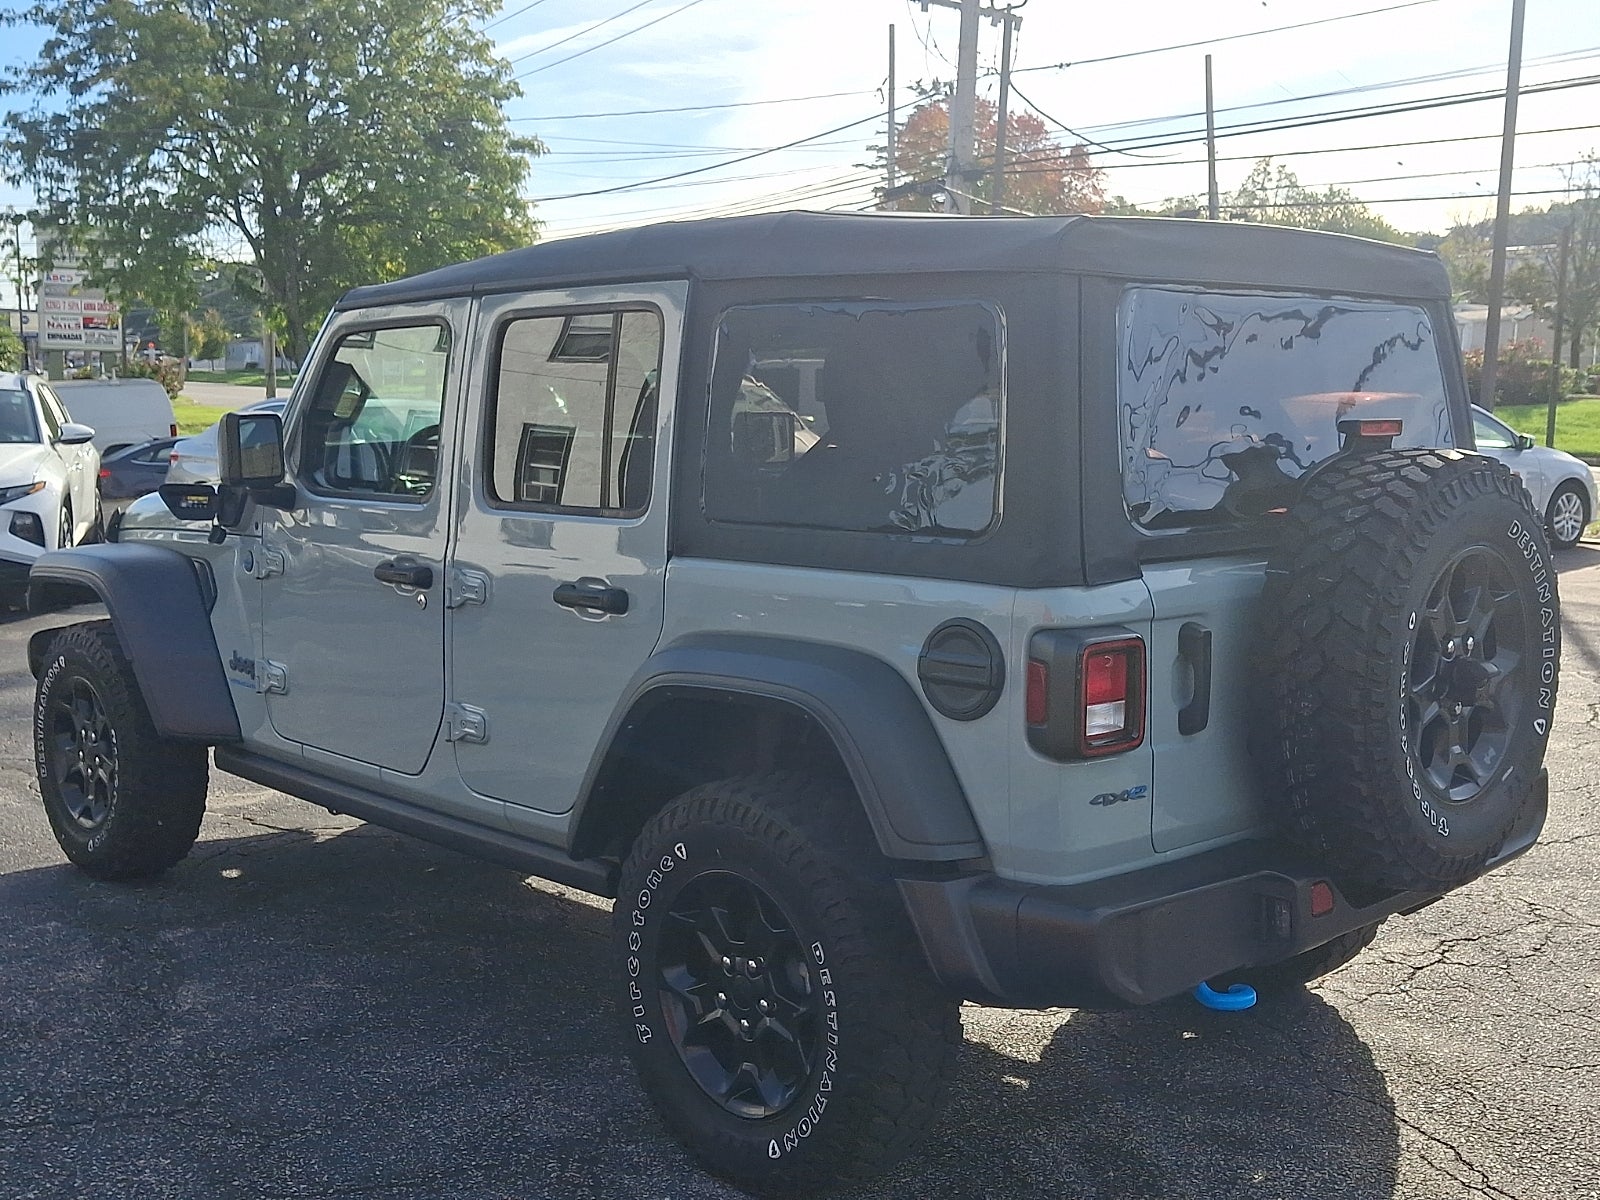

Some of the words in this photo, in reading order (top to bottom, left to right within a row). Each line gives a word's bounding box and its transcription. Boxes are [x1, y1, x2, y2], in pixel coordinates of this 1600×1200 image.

[47, 320, 81, 330] NAILS
[1507, 519, 1554, 709] DESTINATION
[784, 941, 839, 1153] DESTINATION
